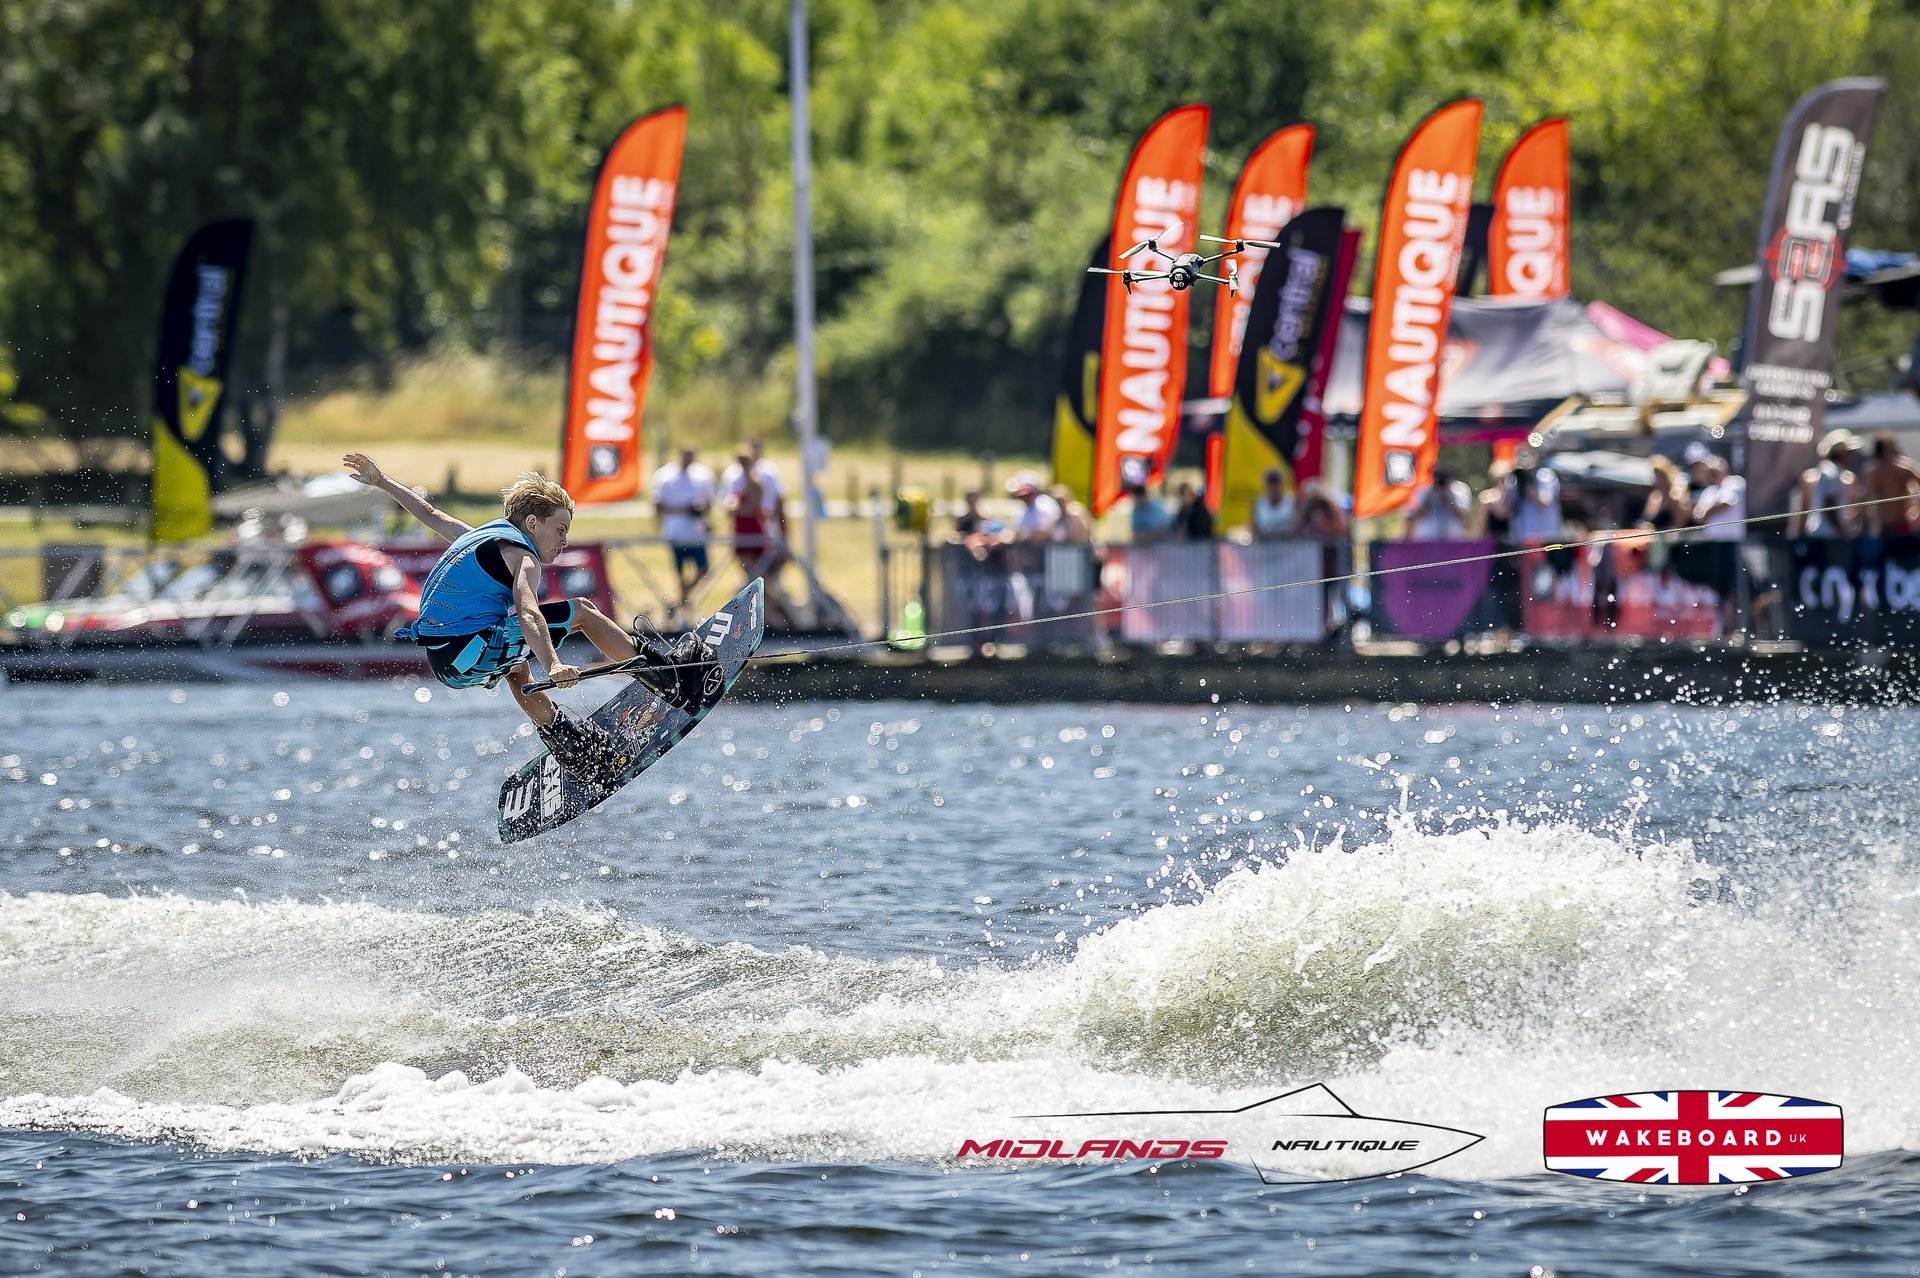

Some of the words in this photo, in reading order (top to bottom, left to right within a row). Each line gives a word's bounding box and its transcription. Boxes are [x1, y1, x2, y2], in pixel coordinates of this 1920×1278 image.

[584, 173, 663, 442] NAUTIQUE
[1115, 175, 1187, 454] NAUTIQUE
[1379, 167, 1460, 448] NAUTIQUE
